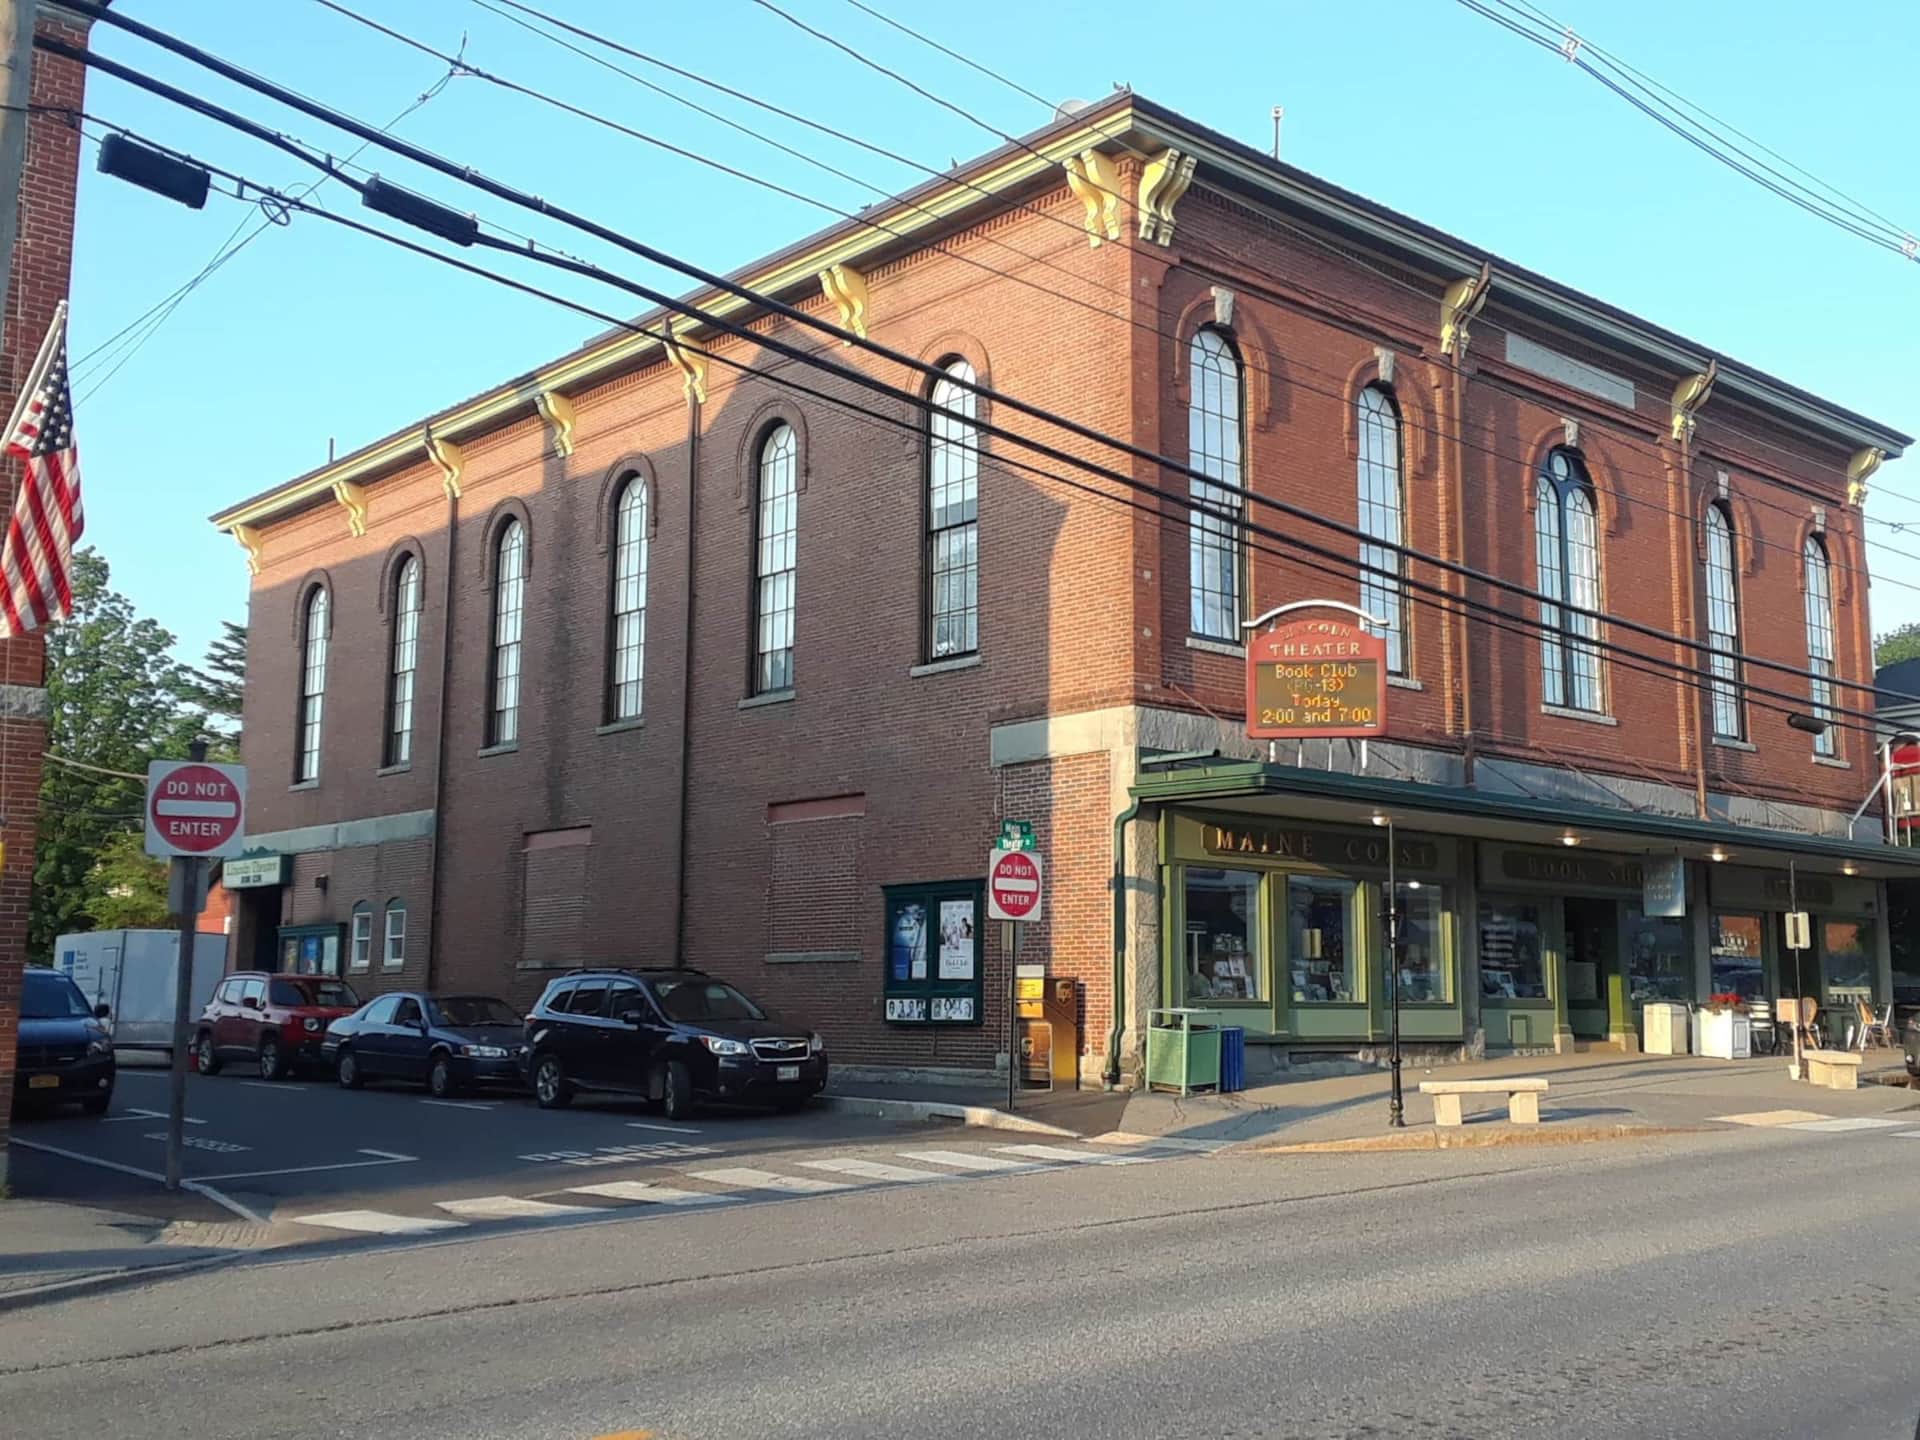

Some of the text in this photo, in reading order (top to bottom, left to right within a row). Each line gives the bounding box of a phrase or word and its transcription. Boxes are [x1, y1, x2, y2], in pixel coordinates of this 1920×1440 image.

[1269, 641, 1361, 657] THEATER
[1275, 663, 1358, 679] Book Club
[1291, 694, 1341, 709] Today
[1262, 708, 1372, 724] 2:00 and 7:00
[167, 780, 228, 797] DO NOT
[169, 821, 222, 837] ENTER
[1216, 827, 1313, 858] MAINE
[1345, 839, 1428, 866] COST
[999, 863, 1033, 877] DO NOT
[1001, 894, 1031, 905] ENTER
